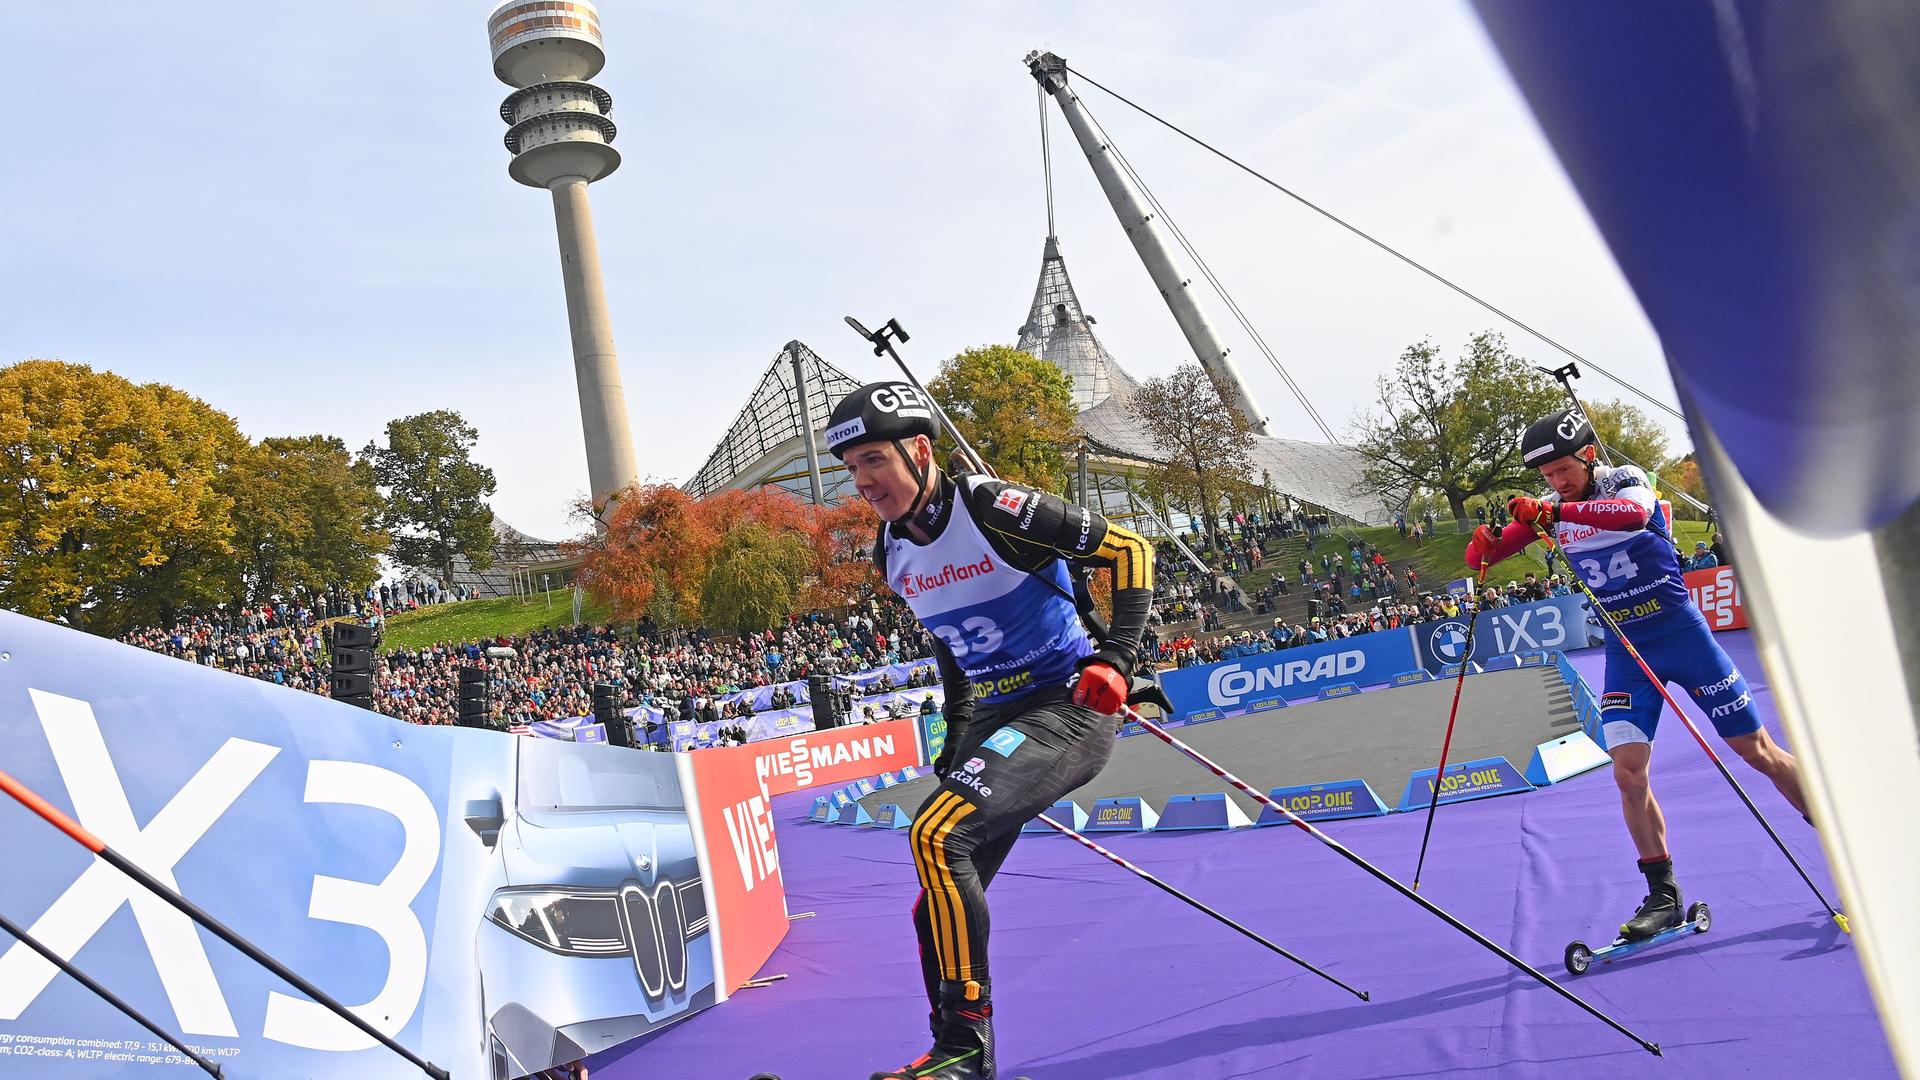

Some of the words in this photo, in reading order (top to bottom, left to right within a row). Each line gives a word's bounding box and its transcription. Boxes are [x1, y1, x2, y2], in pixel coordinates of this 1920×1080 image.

[917, 554, 995, 592] Kaufland
[1578, 549, 1639, 588] 34
[1628, 574, 1671, 597] München
[1434, 624, 1467, 639] BMW
[1491, 605, 1566, 654] iX3
[1207, 650, 1366, 706] CONRAD
[1700, 667, 1740, 696] Tipsport
[1711, 690, 1751, 719] ATEX
[1470, 768, 1502, 786] ONE
[1282, 795, 1321, 811] LOOP
[1324, 791, 1353, 808] ONE
[14, 1045, 64, 1058] CO2-class:
[65, 1048, 77, 1060] A;
[77, 1049, 104, 1060] WLTP
[104, 1051, 136, 1062] electric
[136, 1055, 164, 1066] range:
[16, 1034, 76, 1047] consumption
[77, 1038, 123, 1050] combined:
[124, 1040, 140, 1052] 17,9
[201, 1047, 217, 1057] km;
[217, 1048, 241, 1057] WLTP
